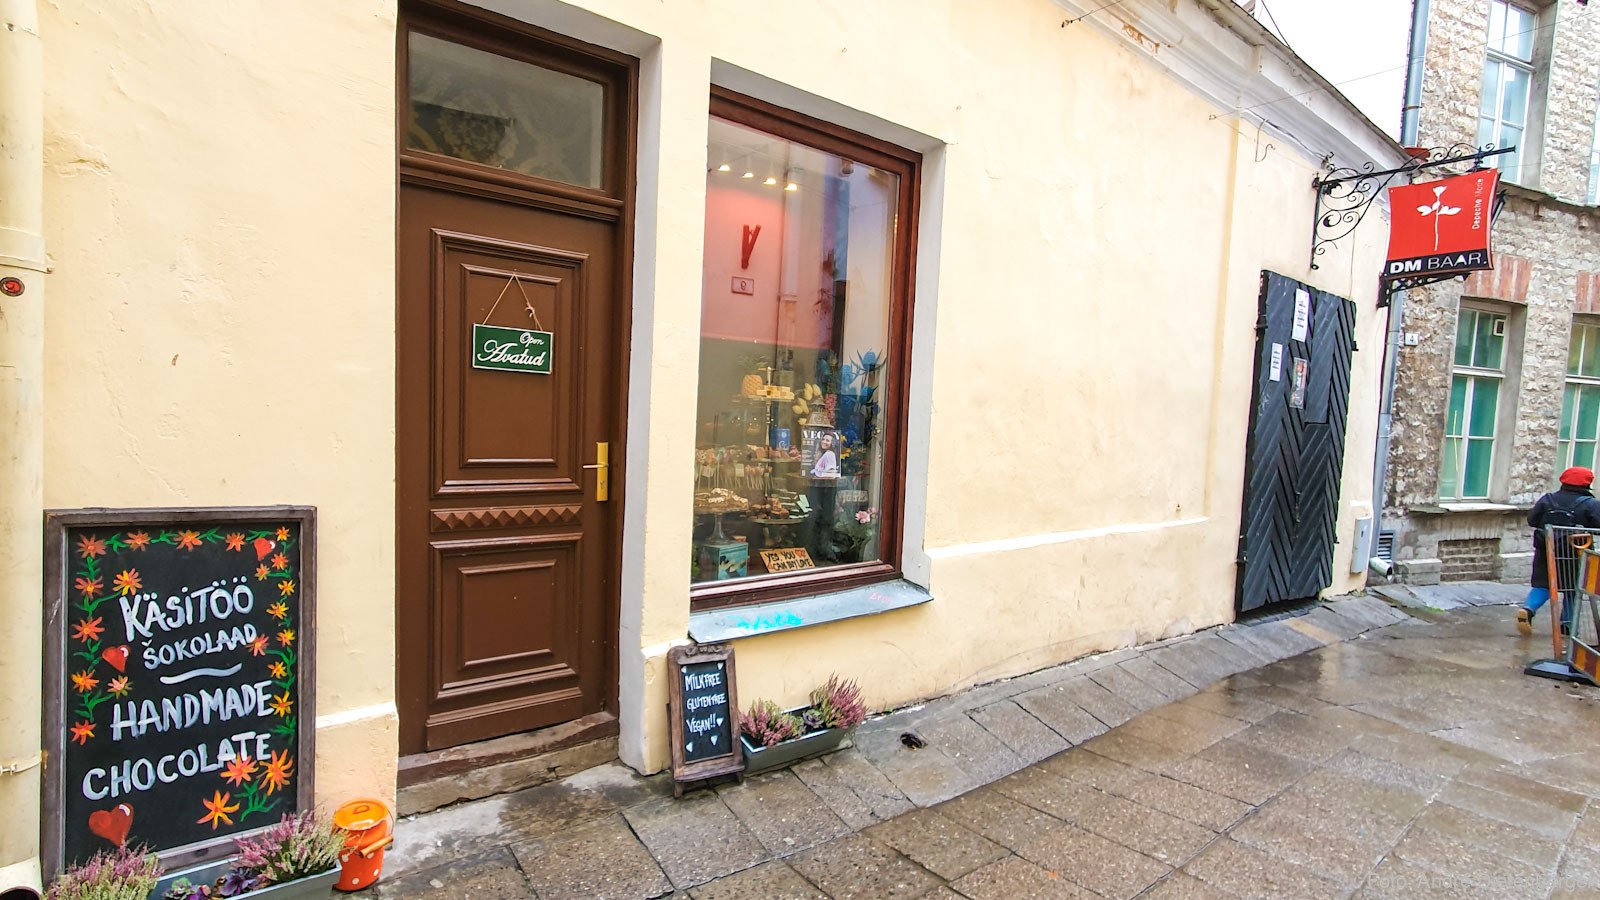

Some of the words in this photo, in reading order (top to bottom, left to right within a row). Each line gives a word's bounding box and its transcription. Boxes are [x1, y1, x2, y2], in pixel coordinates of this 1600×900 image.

[1472, 198, 1481, 230] Depeche
[1390, 260, 1422, 273] DM
[520, 332, 544, 347] Open
[477, 340, 546, 366] Avatud
[781, 551, 795, 560] YOU
[142, 623, 257, 670] ŠOKOLAAD
[110, 679, 275, 742] HANDMADE
[686, 713, 716, 736] VEGAN!!
[82, 731, 273, 802] CHOCOLATE
